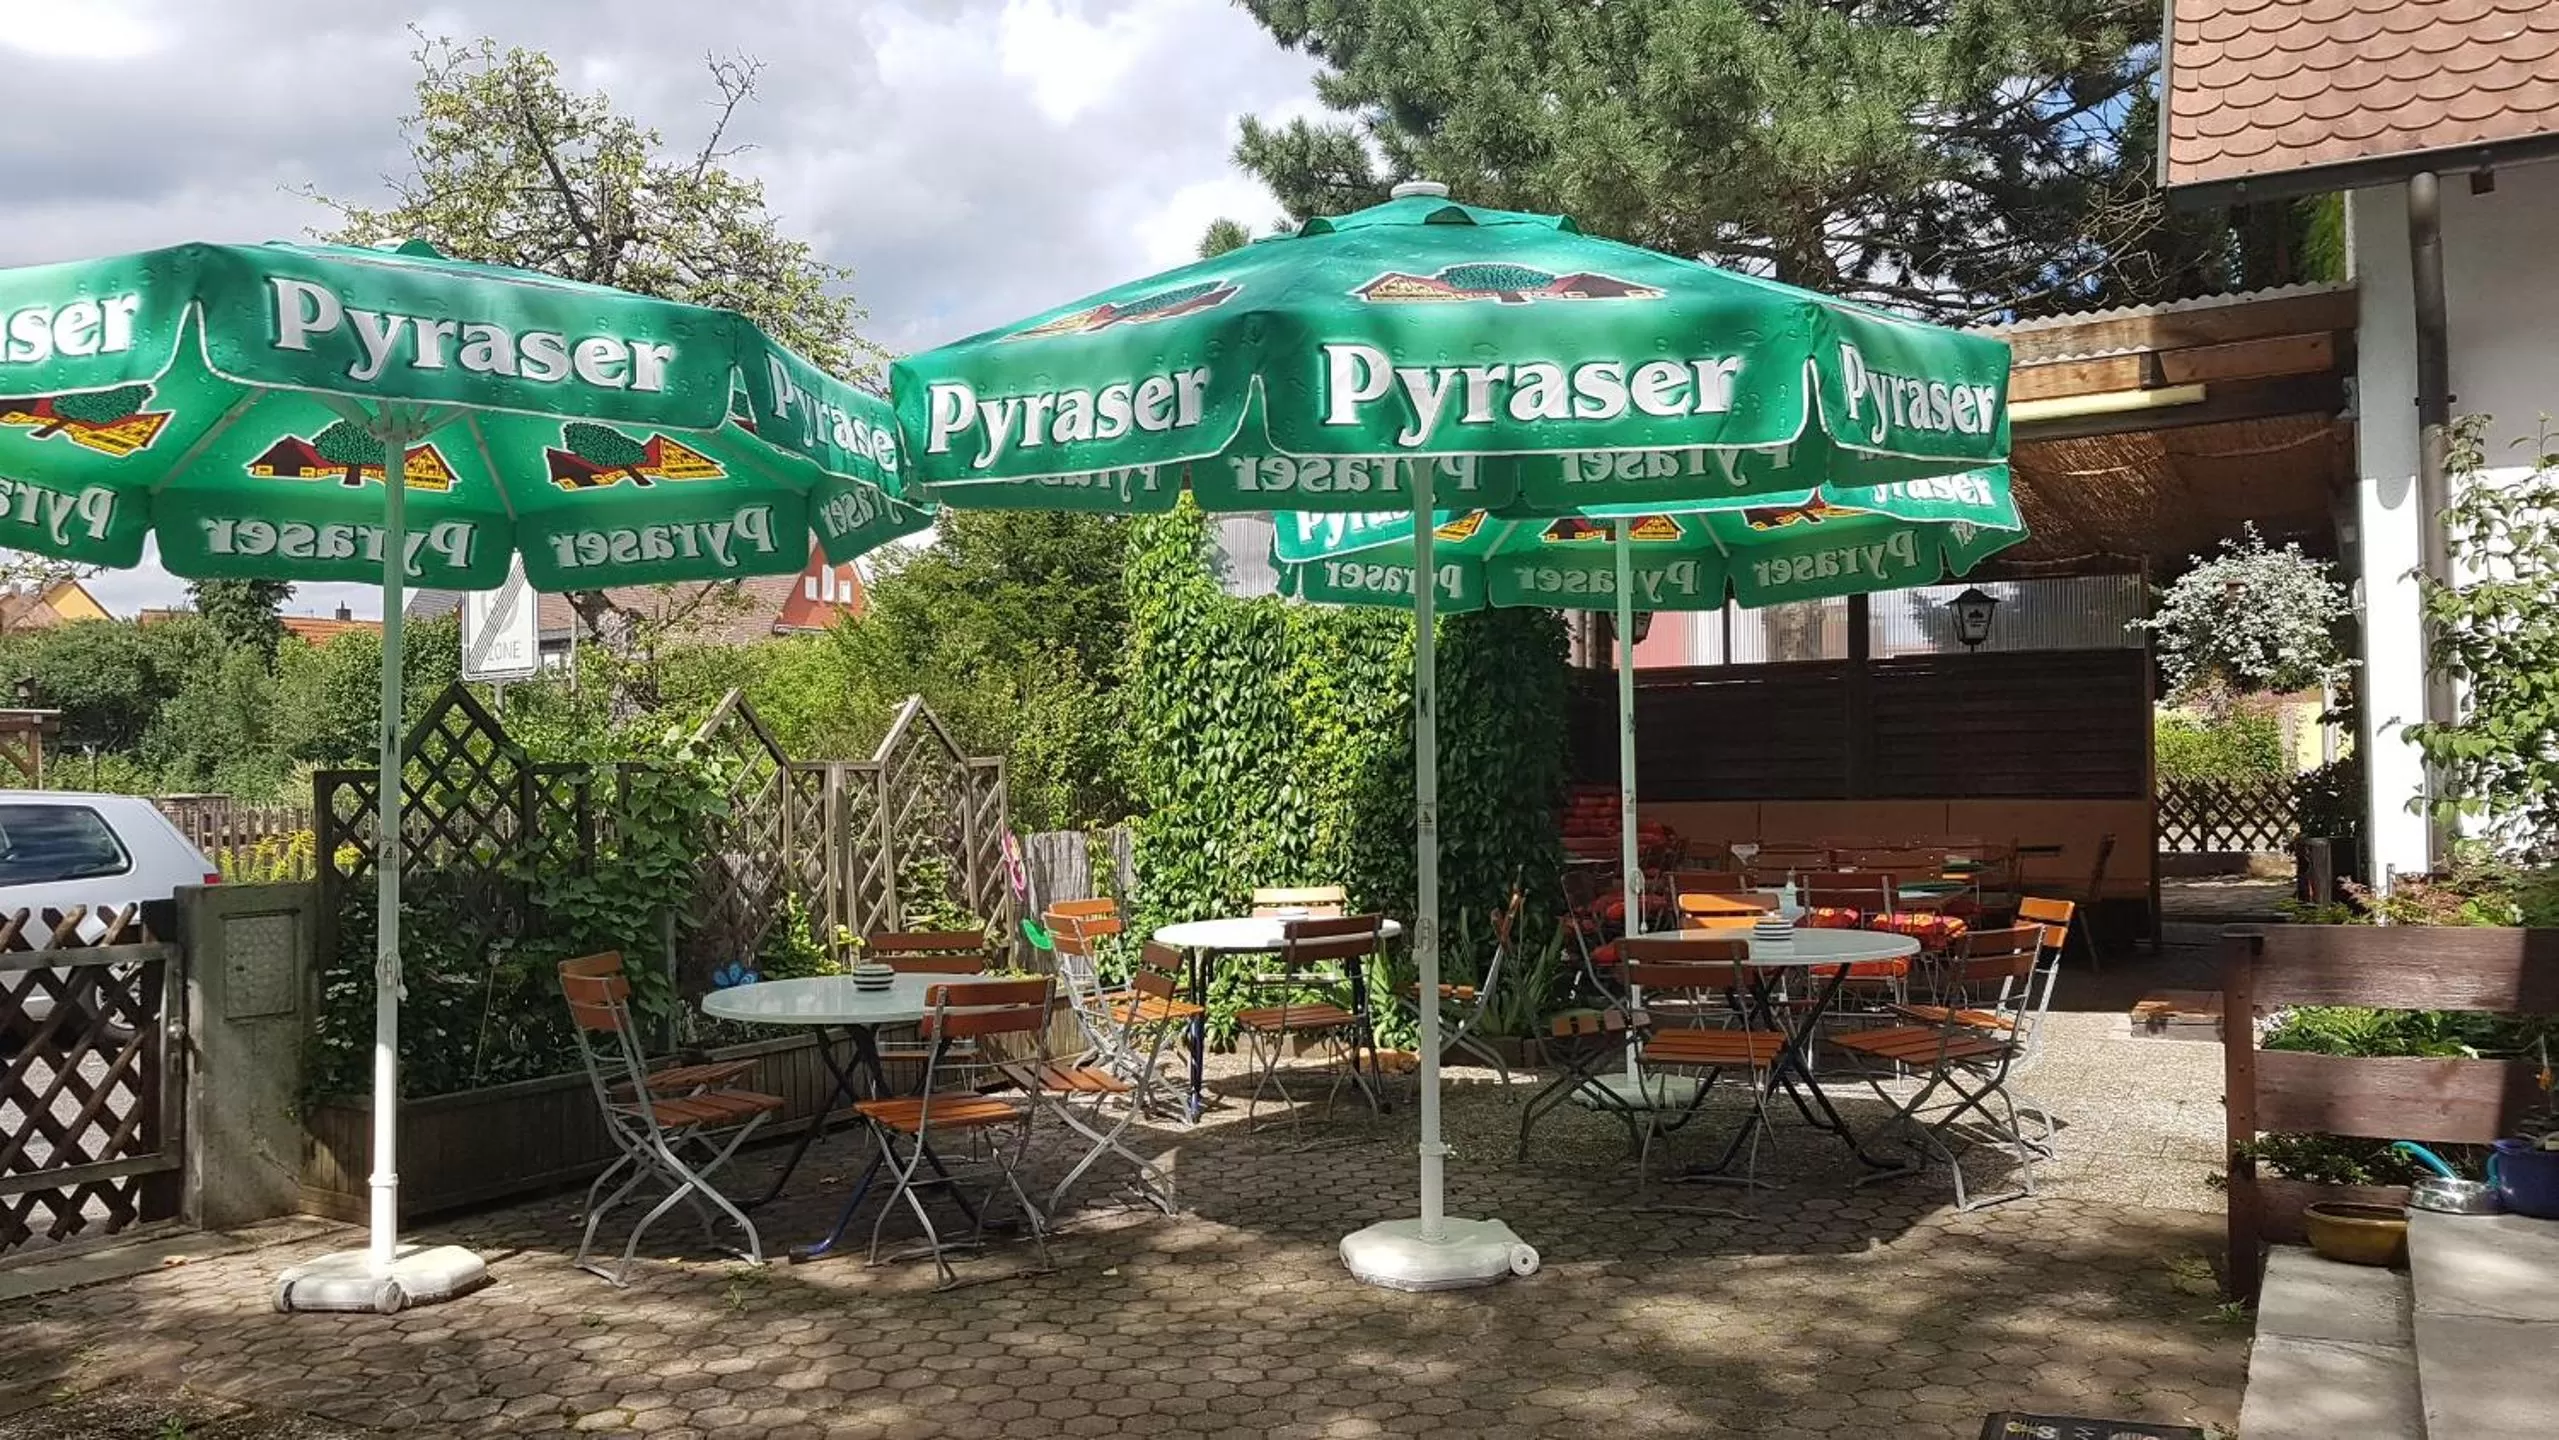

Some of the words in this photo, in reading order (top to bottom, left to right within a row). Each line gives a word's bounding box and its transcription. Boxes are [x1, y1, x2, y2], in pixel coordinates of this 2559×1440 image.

[0, 291, 138, 363] ser
[268, 276, 674, 392] Pyraser
[765, 352, 899, 473] Pyrase
[926, 366, 1211, 468] Pyraser
[1322, 343, 1740, 447] Pyraser
[1838, 344, 1996, 445] Pyraser
